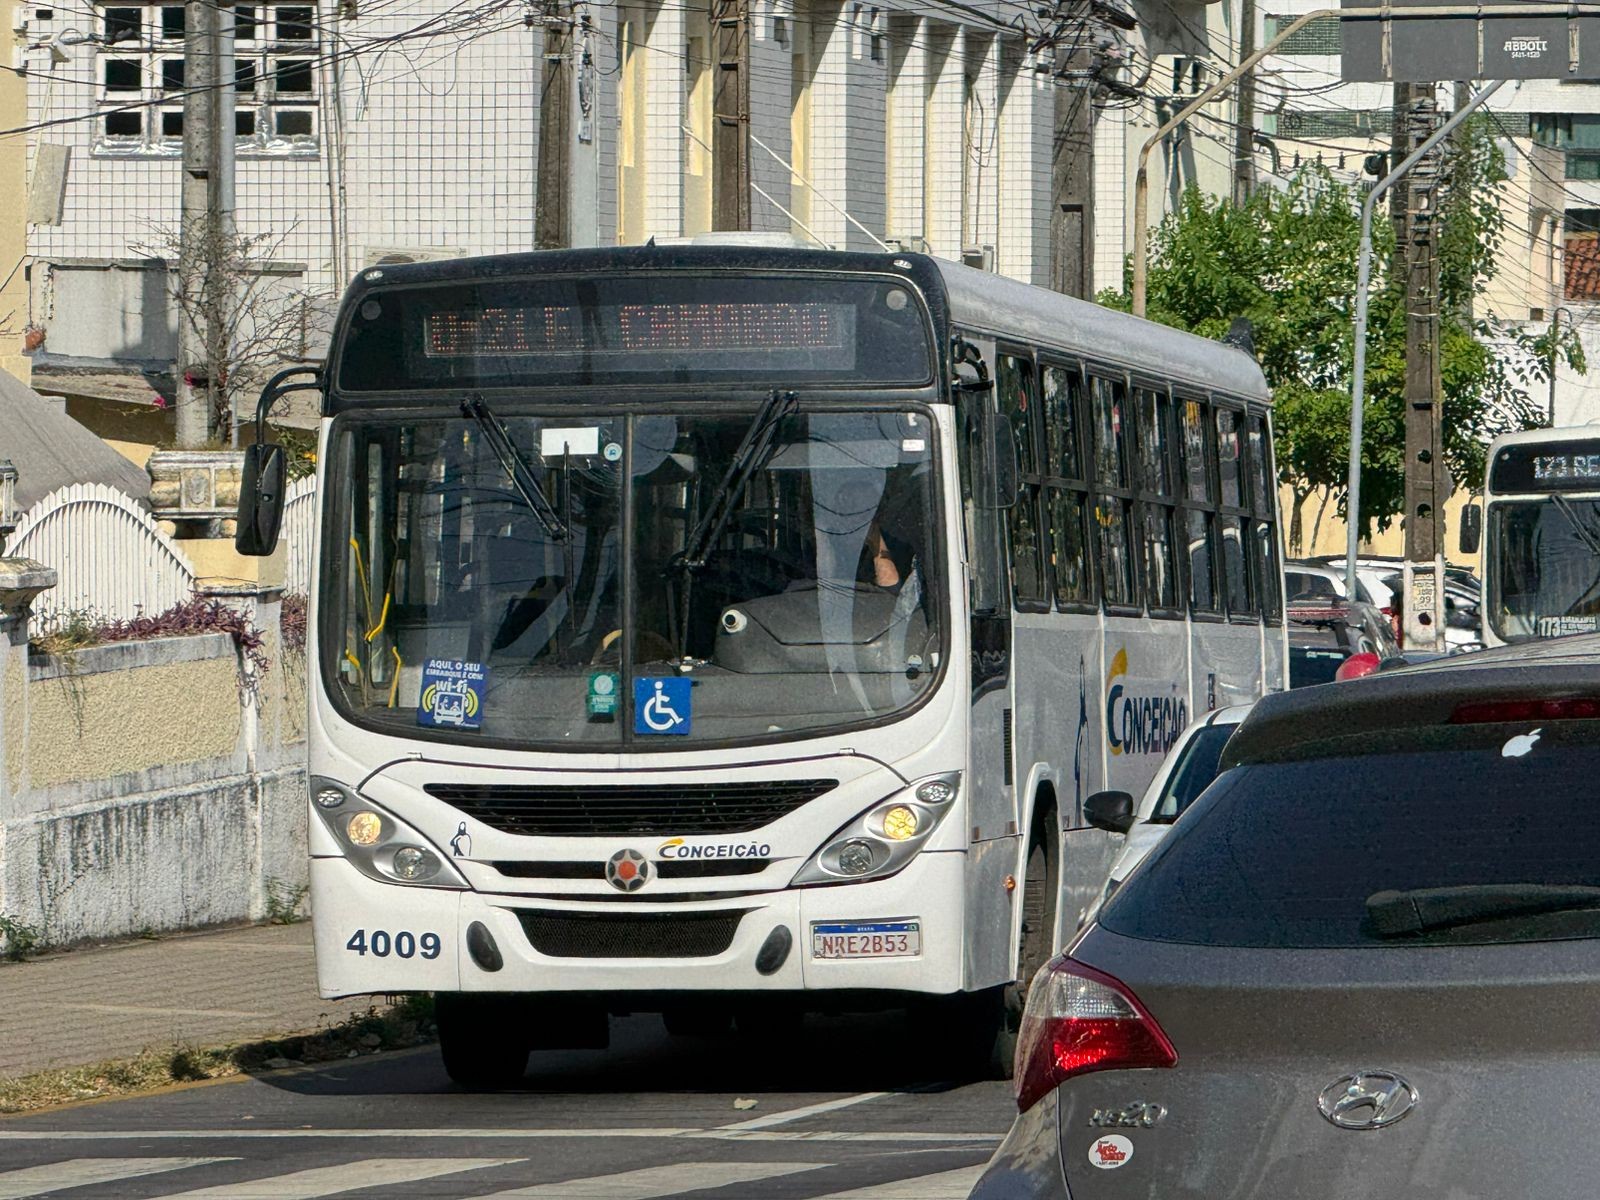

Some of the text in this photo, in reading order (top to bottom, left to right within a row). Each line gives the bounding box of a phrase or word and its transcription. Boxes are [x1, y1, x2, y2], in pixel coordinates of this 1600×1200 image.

[1503, 40, 1548, 51] ABBOTT
[455, 662, 463, 670] O
[464, 662, 480, 672] SEU
[658, 841, 771, 859] CONCEIÇÃO
[346, 929, 441, 960] 4009
[822, 934, 908, 954] NRE2B53
